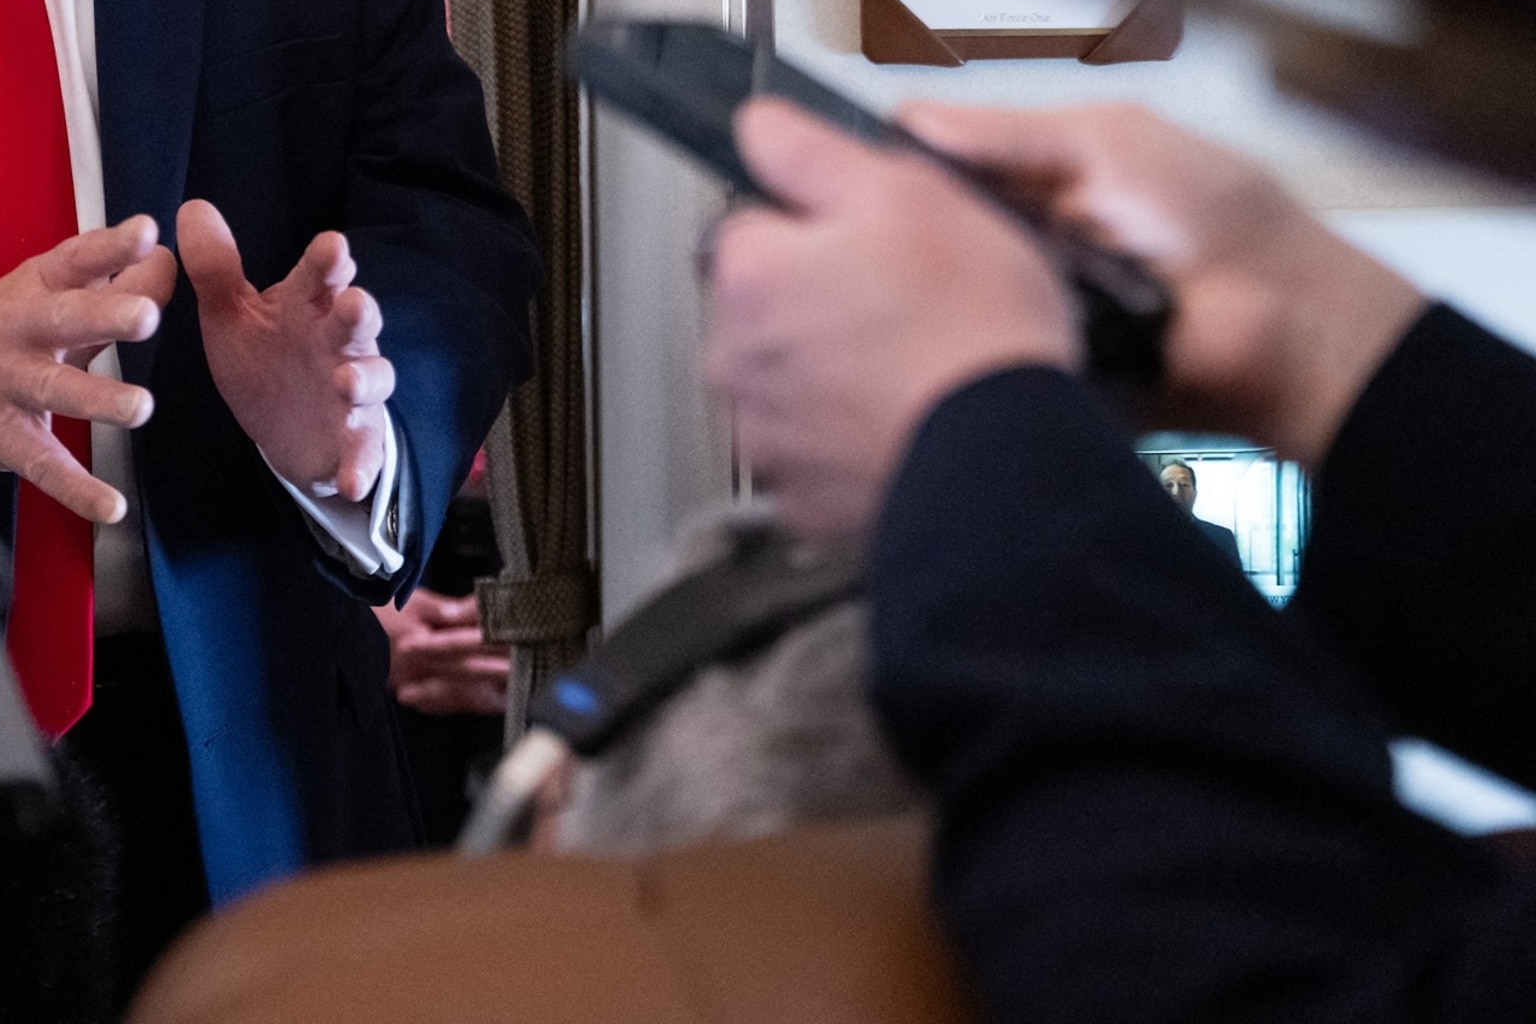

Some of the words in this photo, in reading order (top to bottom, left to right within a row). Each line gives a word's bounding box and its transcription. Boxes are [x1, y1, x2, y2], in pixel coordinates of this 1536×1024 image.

[979, 13, 998, 23] Air
[999, 12, 1028, 23] Force
[1029, 12, 1050, 23] One
